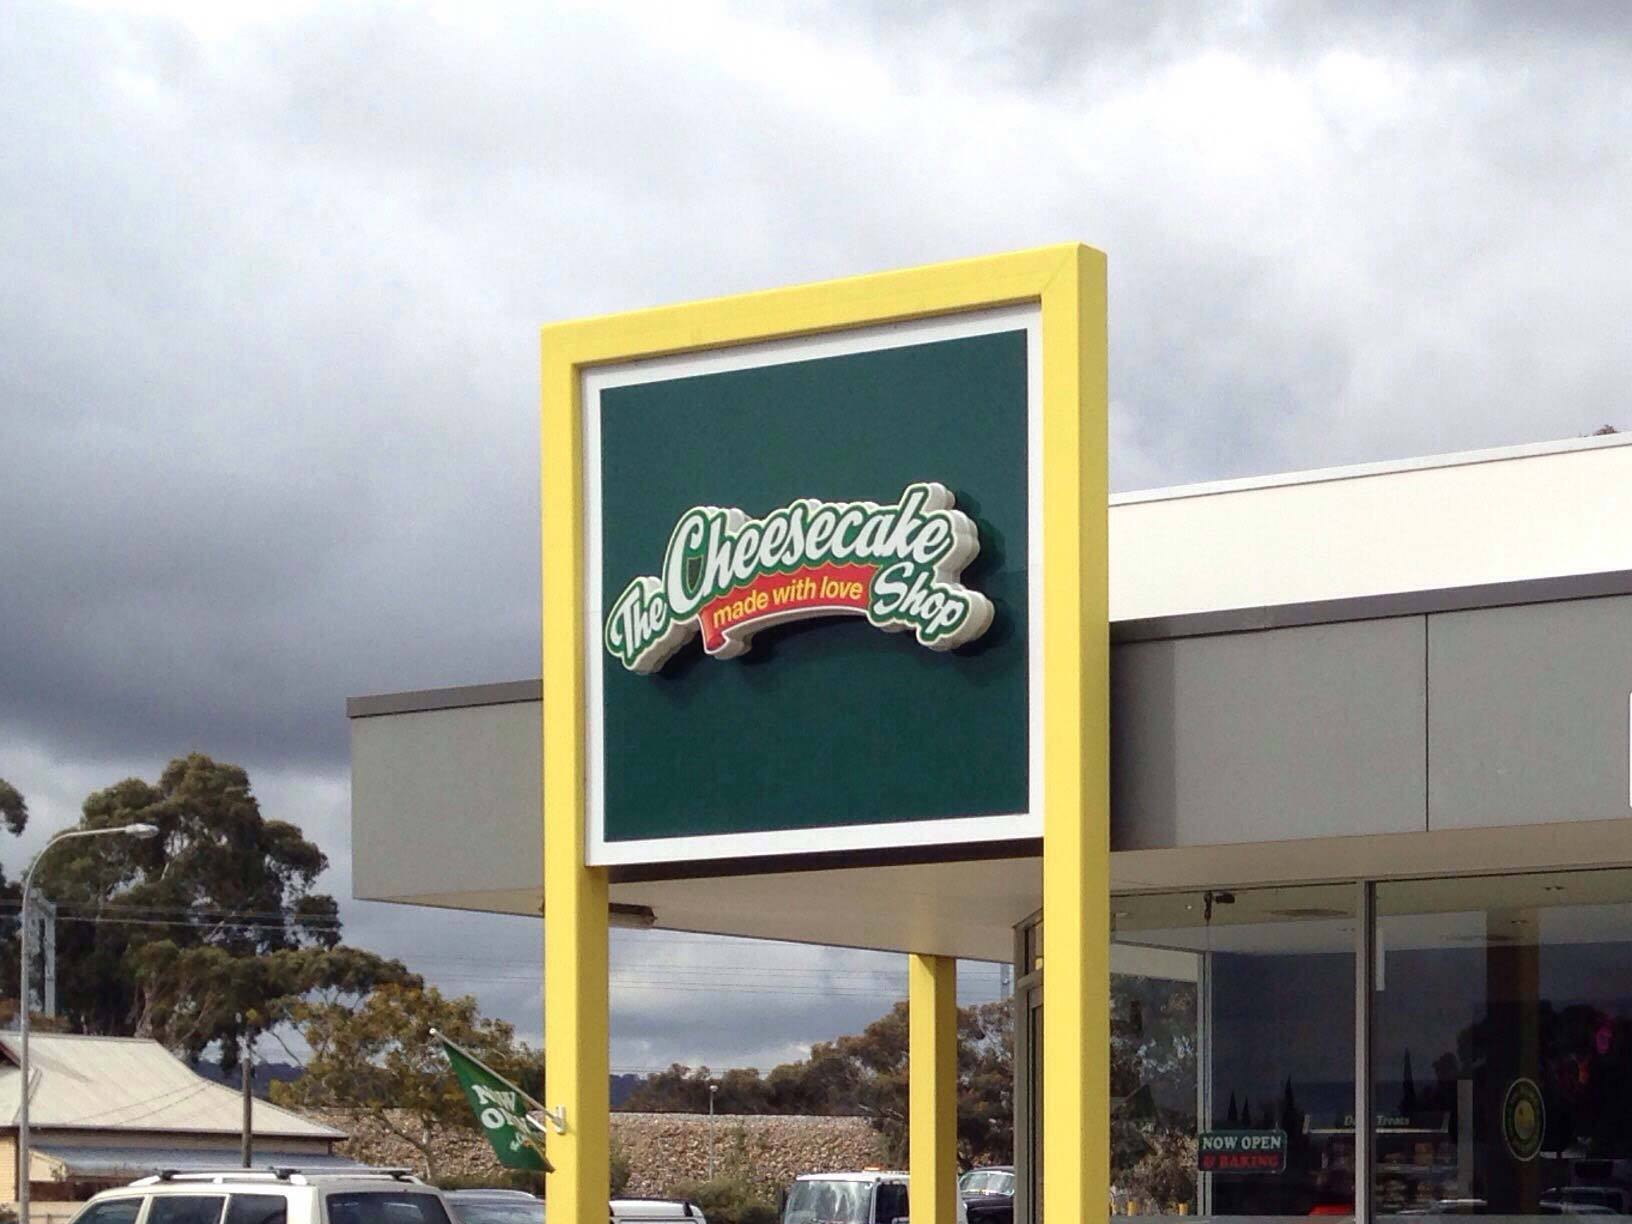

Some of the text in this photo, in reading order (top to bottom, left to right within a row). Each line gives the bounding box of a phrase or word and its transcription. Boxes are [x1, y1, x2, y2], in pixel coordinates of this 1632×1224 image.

[610, 486, 953, 658] The Cheesecake
[713, 575, 864, 629] made with love
[874, 565, 966, 636] Shop
[1202, 1136, 1281, 1150] NOW OPEN
